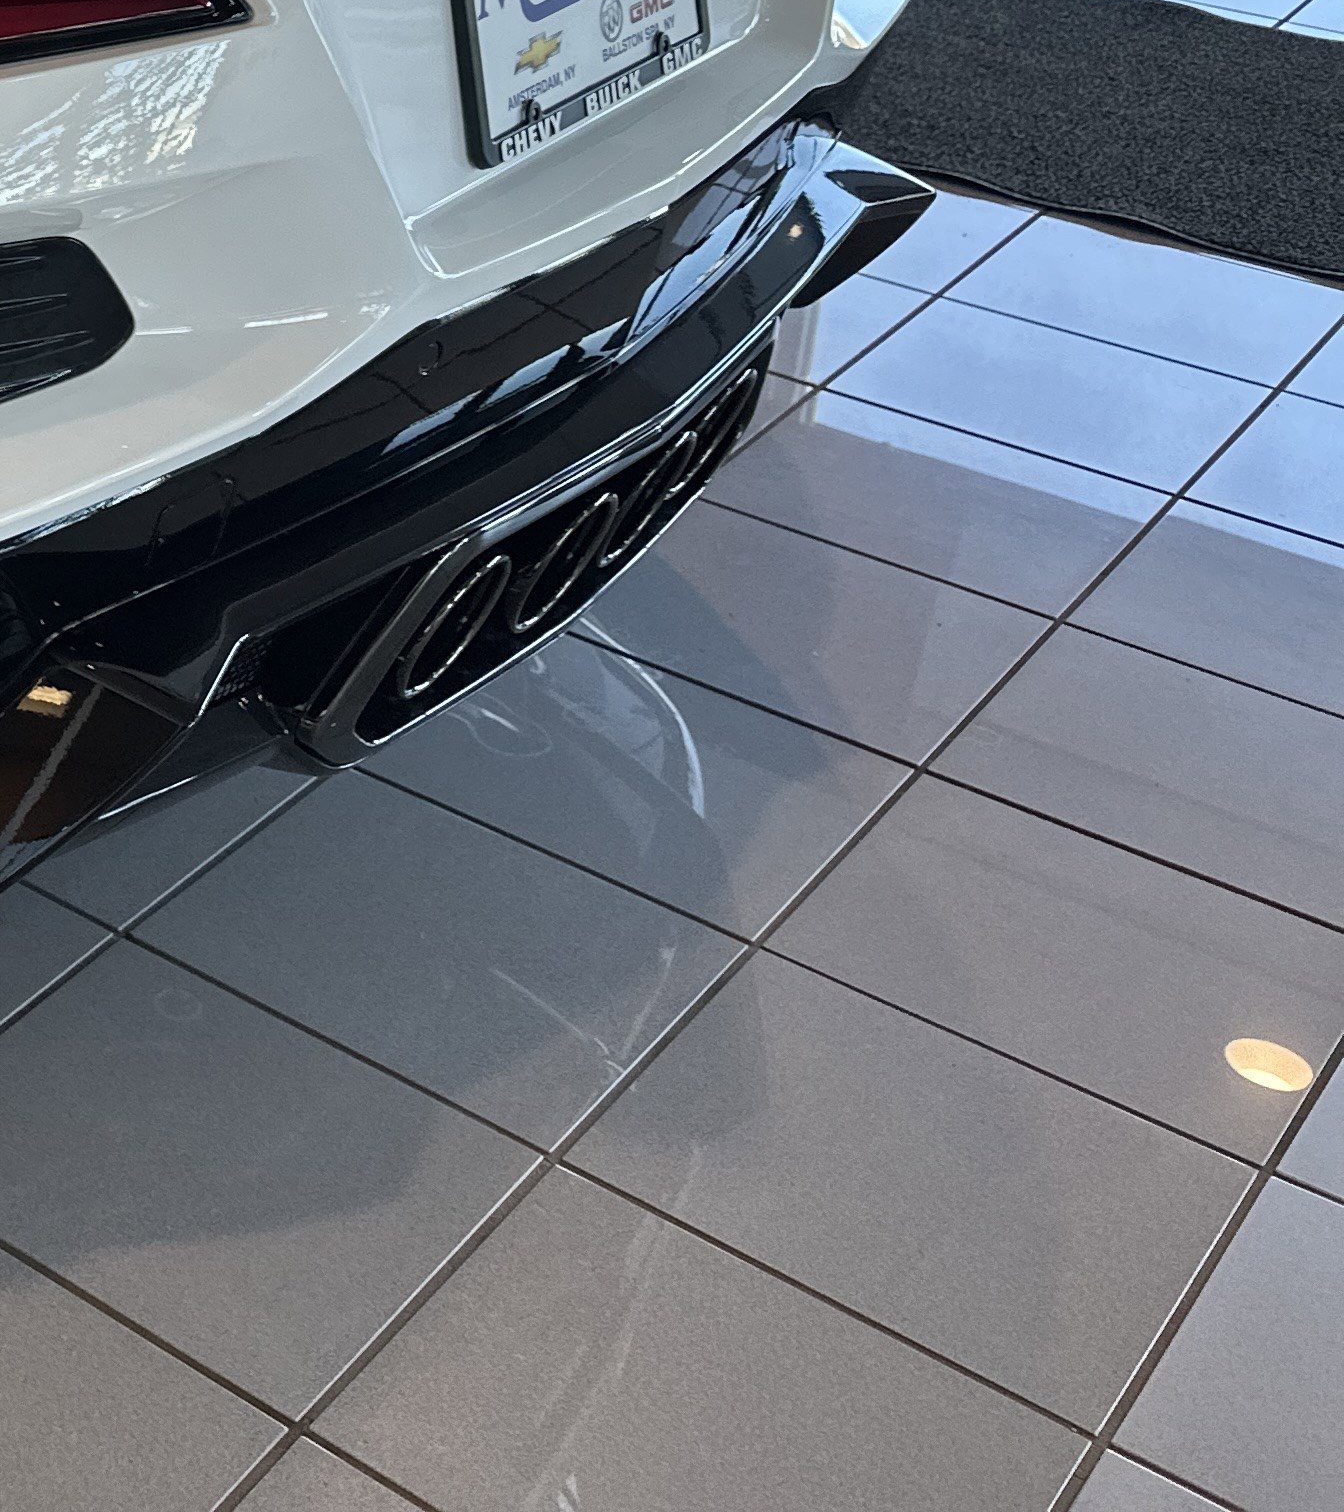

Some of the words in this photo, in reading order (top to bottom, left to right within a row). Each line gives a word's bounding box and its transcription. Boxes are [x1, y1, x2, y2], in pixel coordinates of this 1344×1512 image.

[601, 34, 645, 63] BALLSTON
[563, 63, 577, 82] NY
[499, 110, 563, 163] CHEVY
[584, 68, 644, 117] BUICK
[660, 38, 703, 74] GMC
